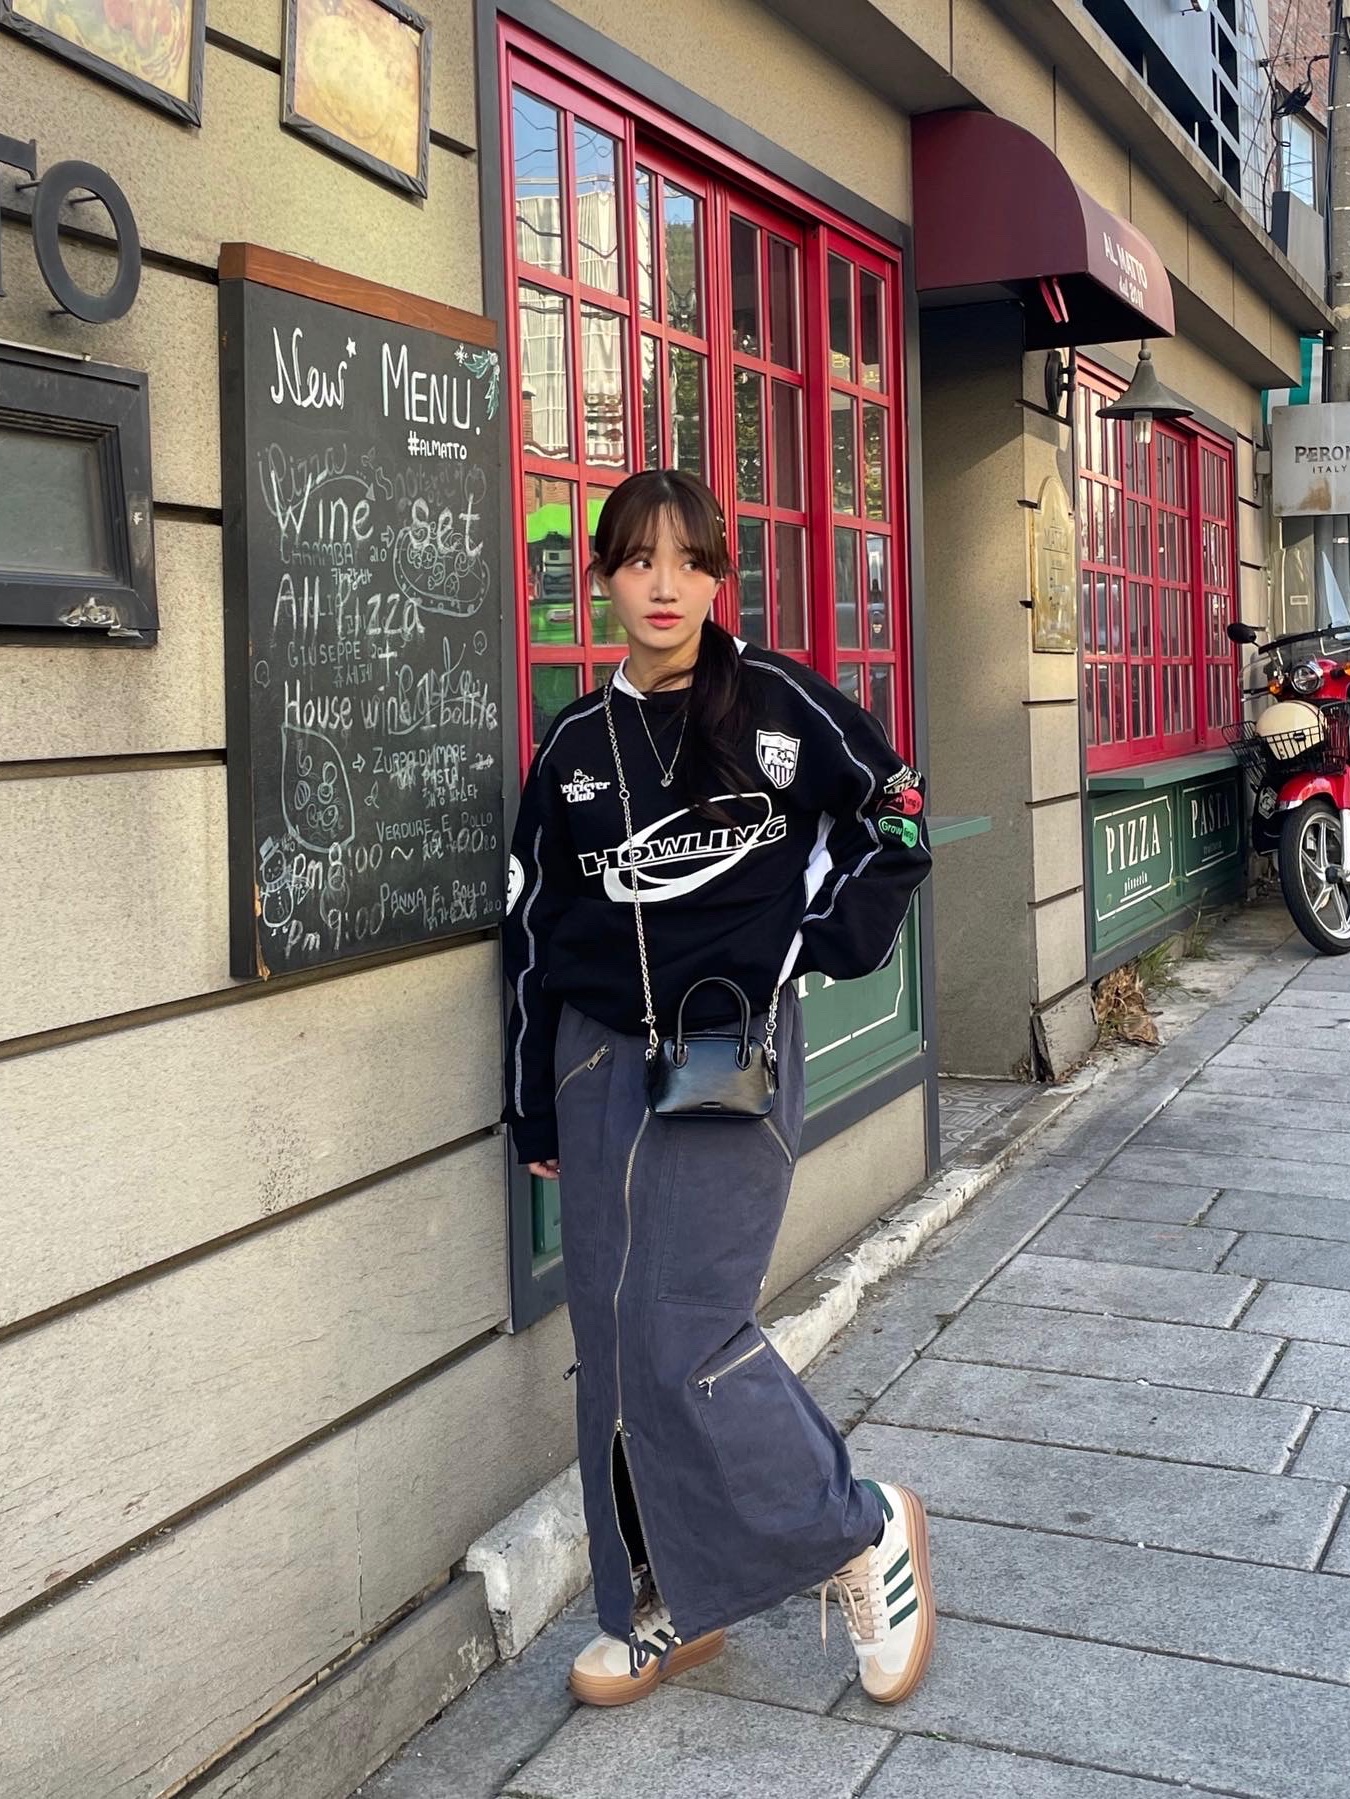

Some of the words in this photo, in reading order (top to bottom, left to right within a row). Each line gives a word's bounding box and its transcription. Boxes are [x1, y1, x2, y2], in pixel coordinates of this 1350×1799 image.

[1103, 231, 1118, 266] AL
[1116, 243, 1148, 289] MATTO
[270, 327, 348, 410] New
[407, 430, 468, 460] #ALMATTO
[1312, 464, 1347, 474] ITALY
[270, 469, 374, 543] Wine
[410, 493, 484, 557] Set
[272, 573, 321, 634] All
[287, 640, 362, 668] GIUSEPPE
[284, 679, 353, 730] House
[560, 781, 611, 794] etriever
[566, 790, 595, 803] Club
[375, 818, 434, 844] VERDURE
[461, 811, 493, 829] POLLO
[1191, 792, 1231, 839] PASTA
[578, 815, 788, 876] HOWLING
[1105, 813, 1161, 875] PIZZA
